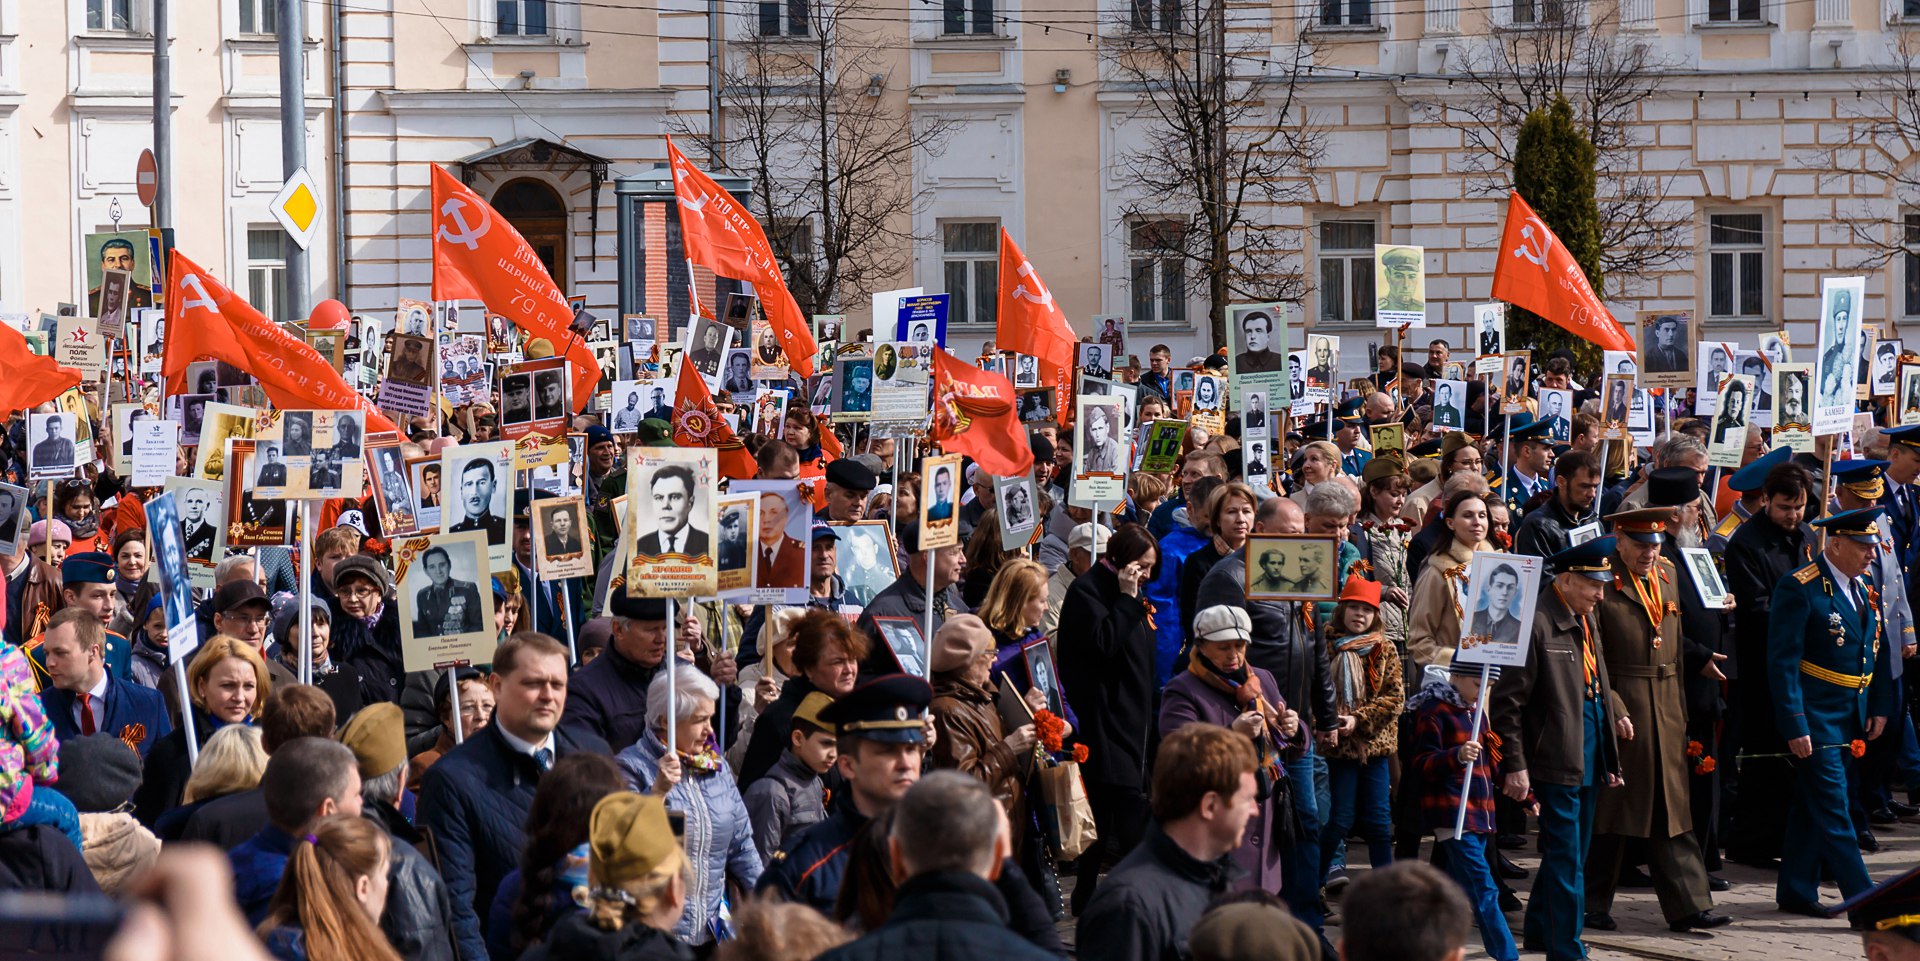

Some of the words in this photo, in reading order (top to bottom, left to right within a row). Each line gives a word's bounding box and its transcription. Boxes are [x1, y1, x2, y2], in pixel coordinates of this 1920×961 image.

[712, 193, 731, 215] 150
[510, 288, 536, 314] 79
[1569, 302, 1590, 325] 79
